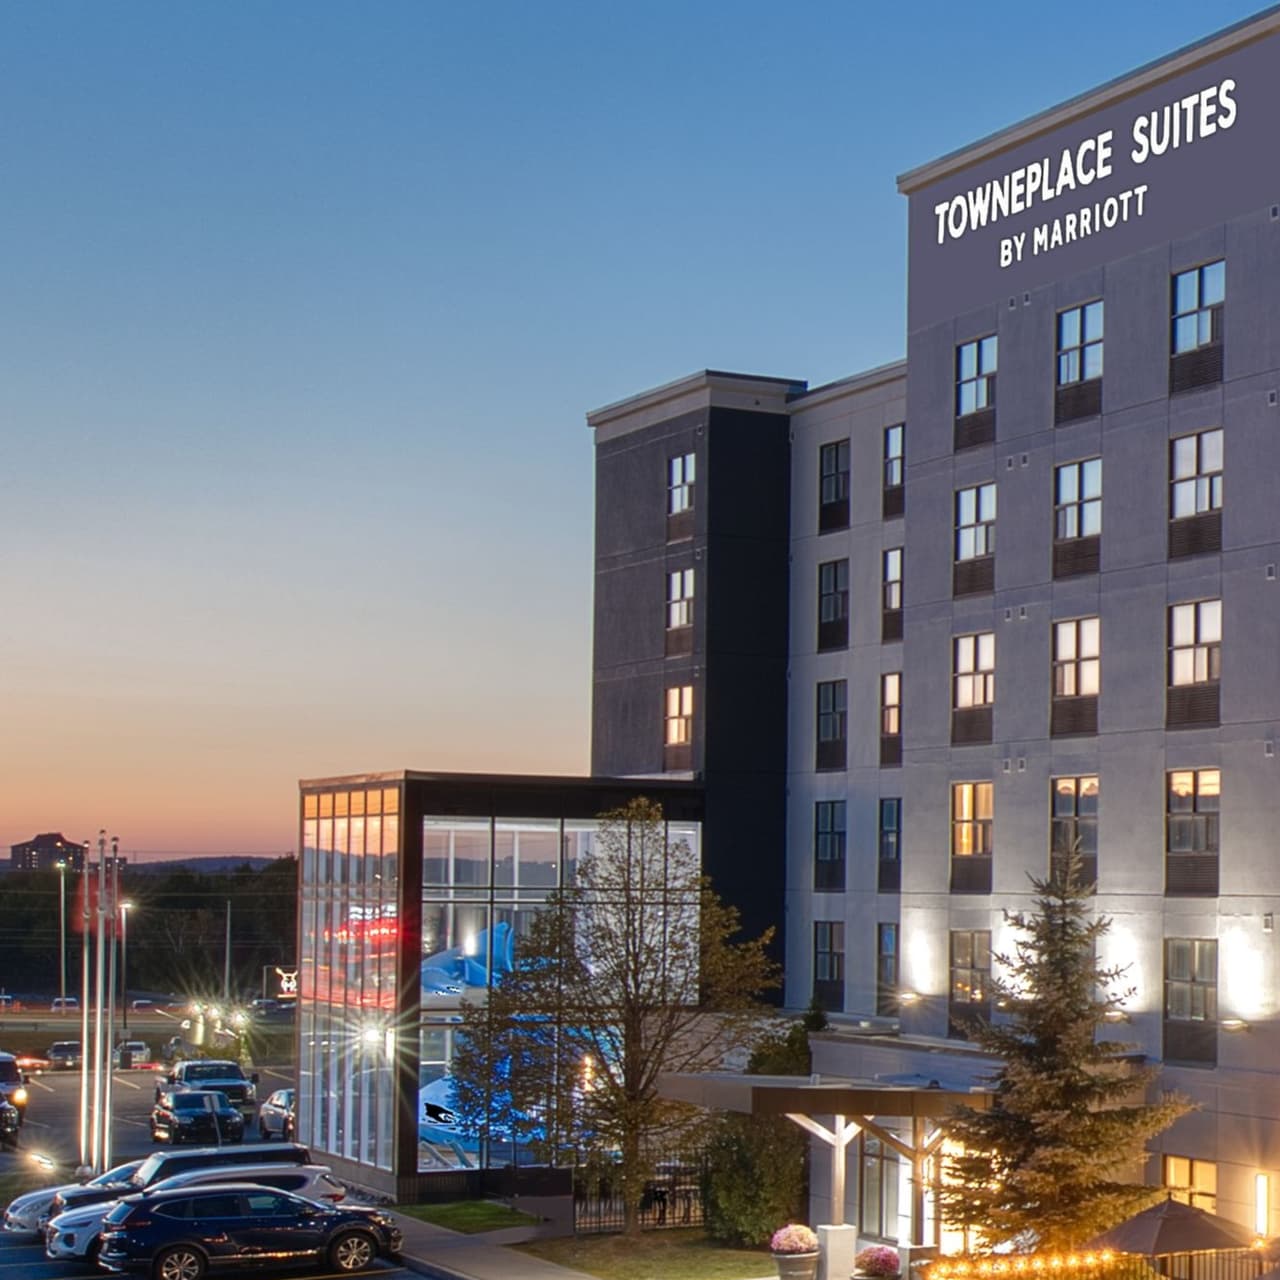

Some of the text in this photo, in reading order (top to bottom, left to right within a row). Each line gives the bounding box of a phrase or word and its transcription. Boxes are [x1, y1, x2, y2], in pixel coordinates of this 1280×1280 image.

[934, 79, 1237, 245] TOWNEPLACE SUITES
[1000, 184, 1148, 268] BY MARRIOTT
